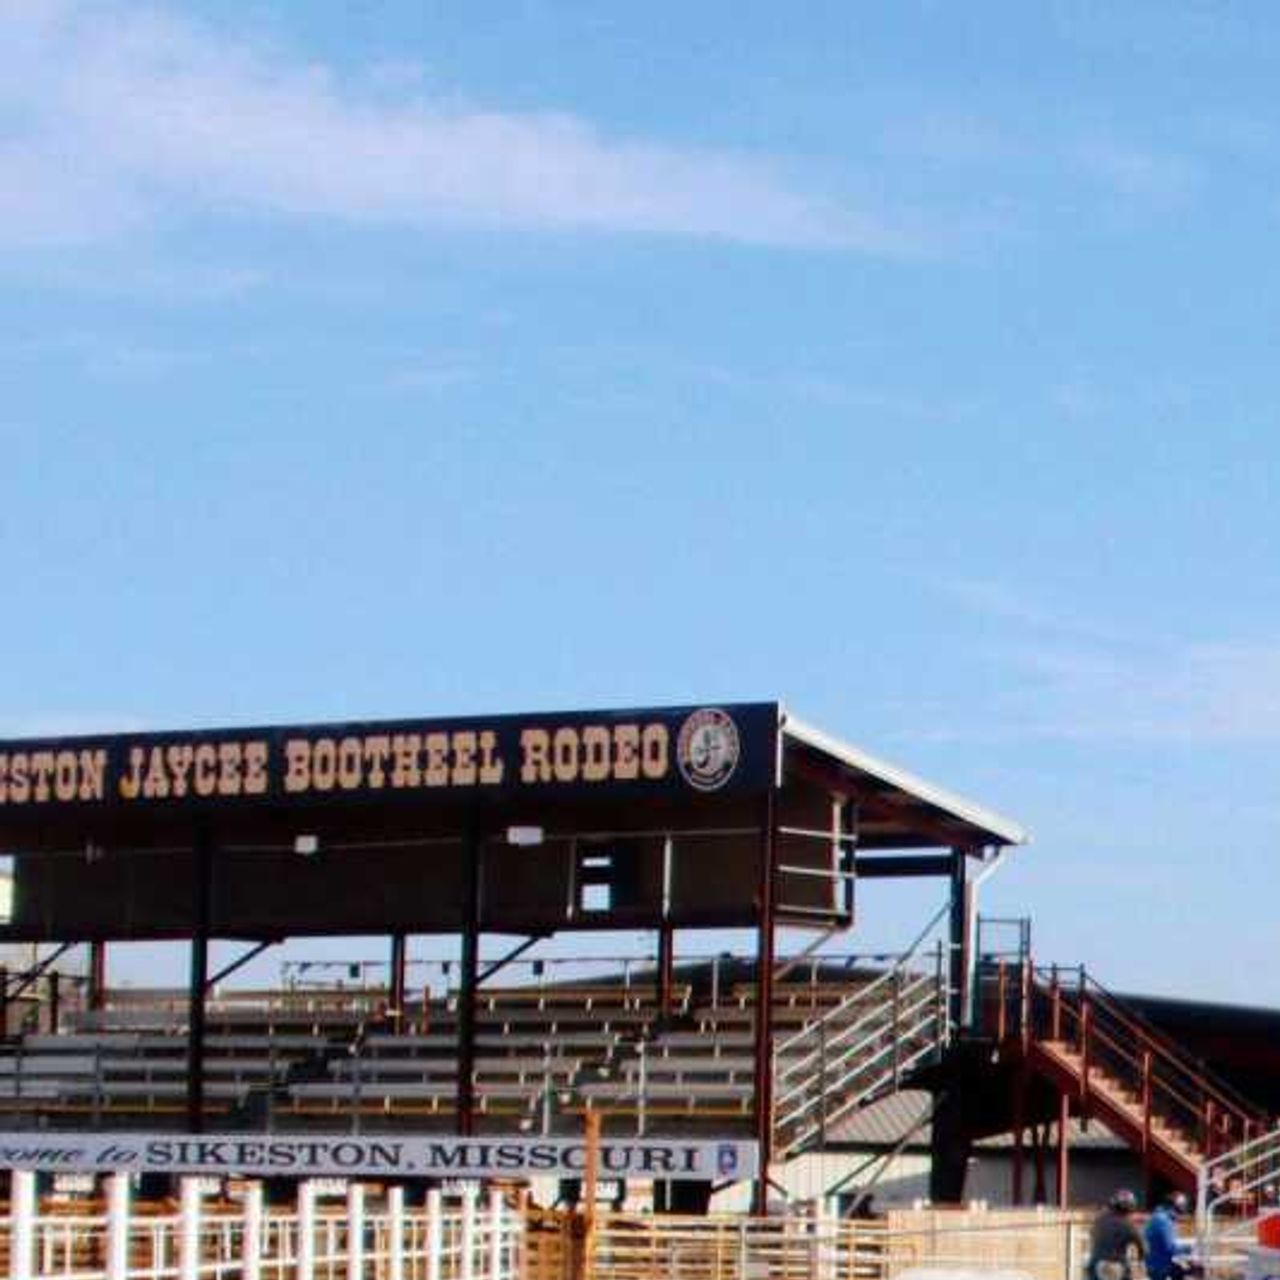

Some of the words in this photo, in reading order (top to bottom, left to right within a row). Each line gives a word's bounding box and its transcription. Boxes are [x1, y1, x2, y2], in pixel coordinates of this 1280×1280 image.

[118, 741, 269, 799] JAYCEE
[284, 730, 504, 793] BOOTHEEL
[520, 721, 669, 783] RODEO
[96, 1144, 139, 1164] to
[145, 1140, 415, 1170] SIKESTON,
[428, 1143, 699, 1172] MISSOURI
